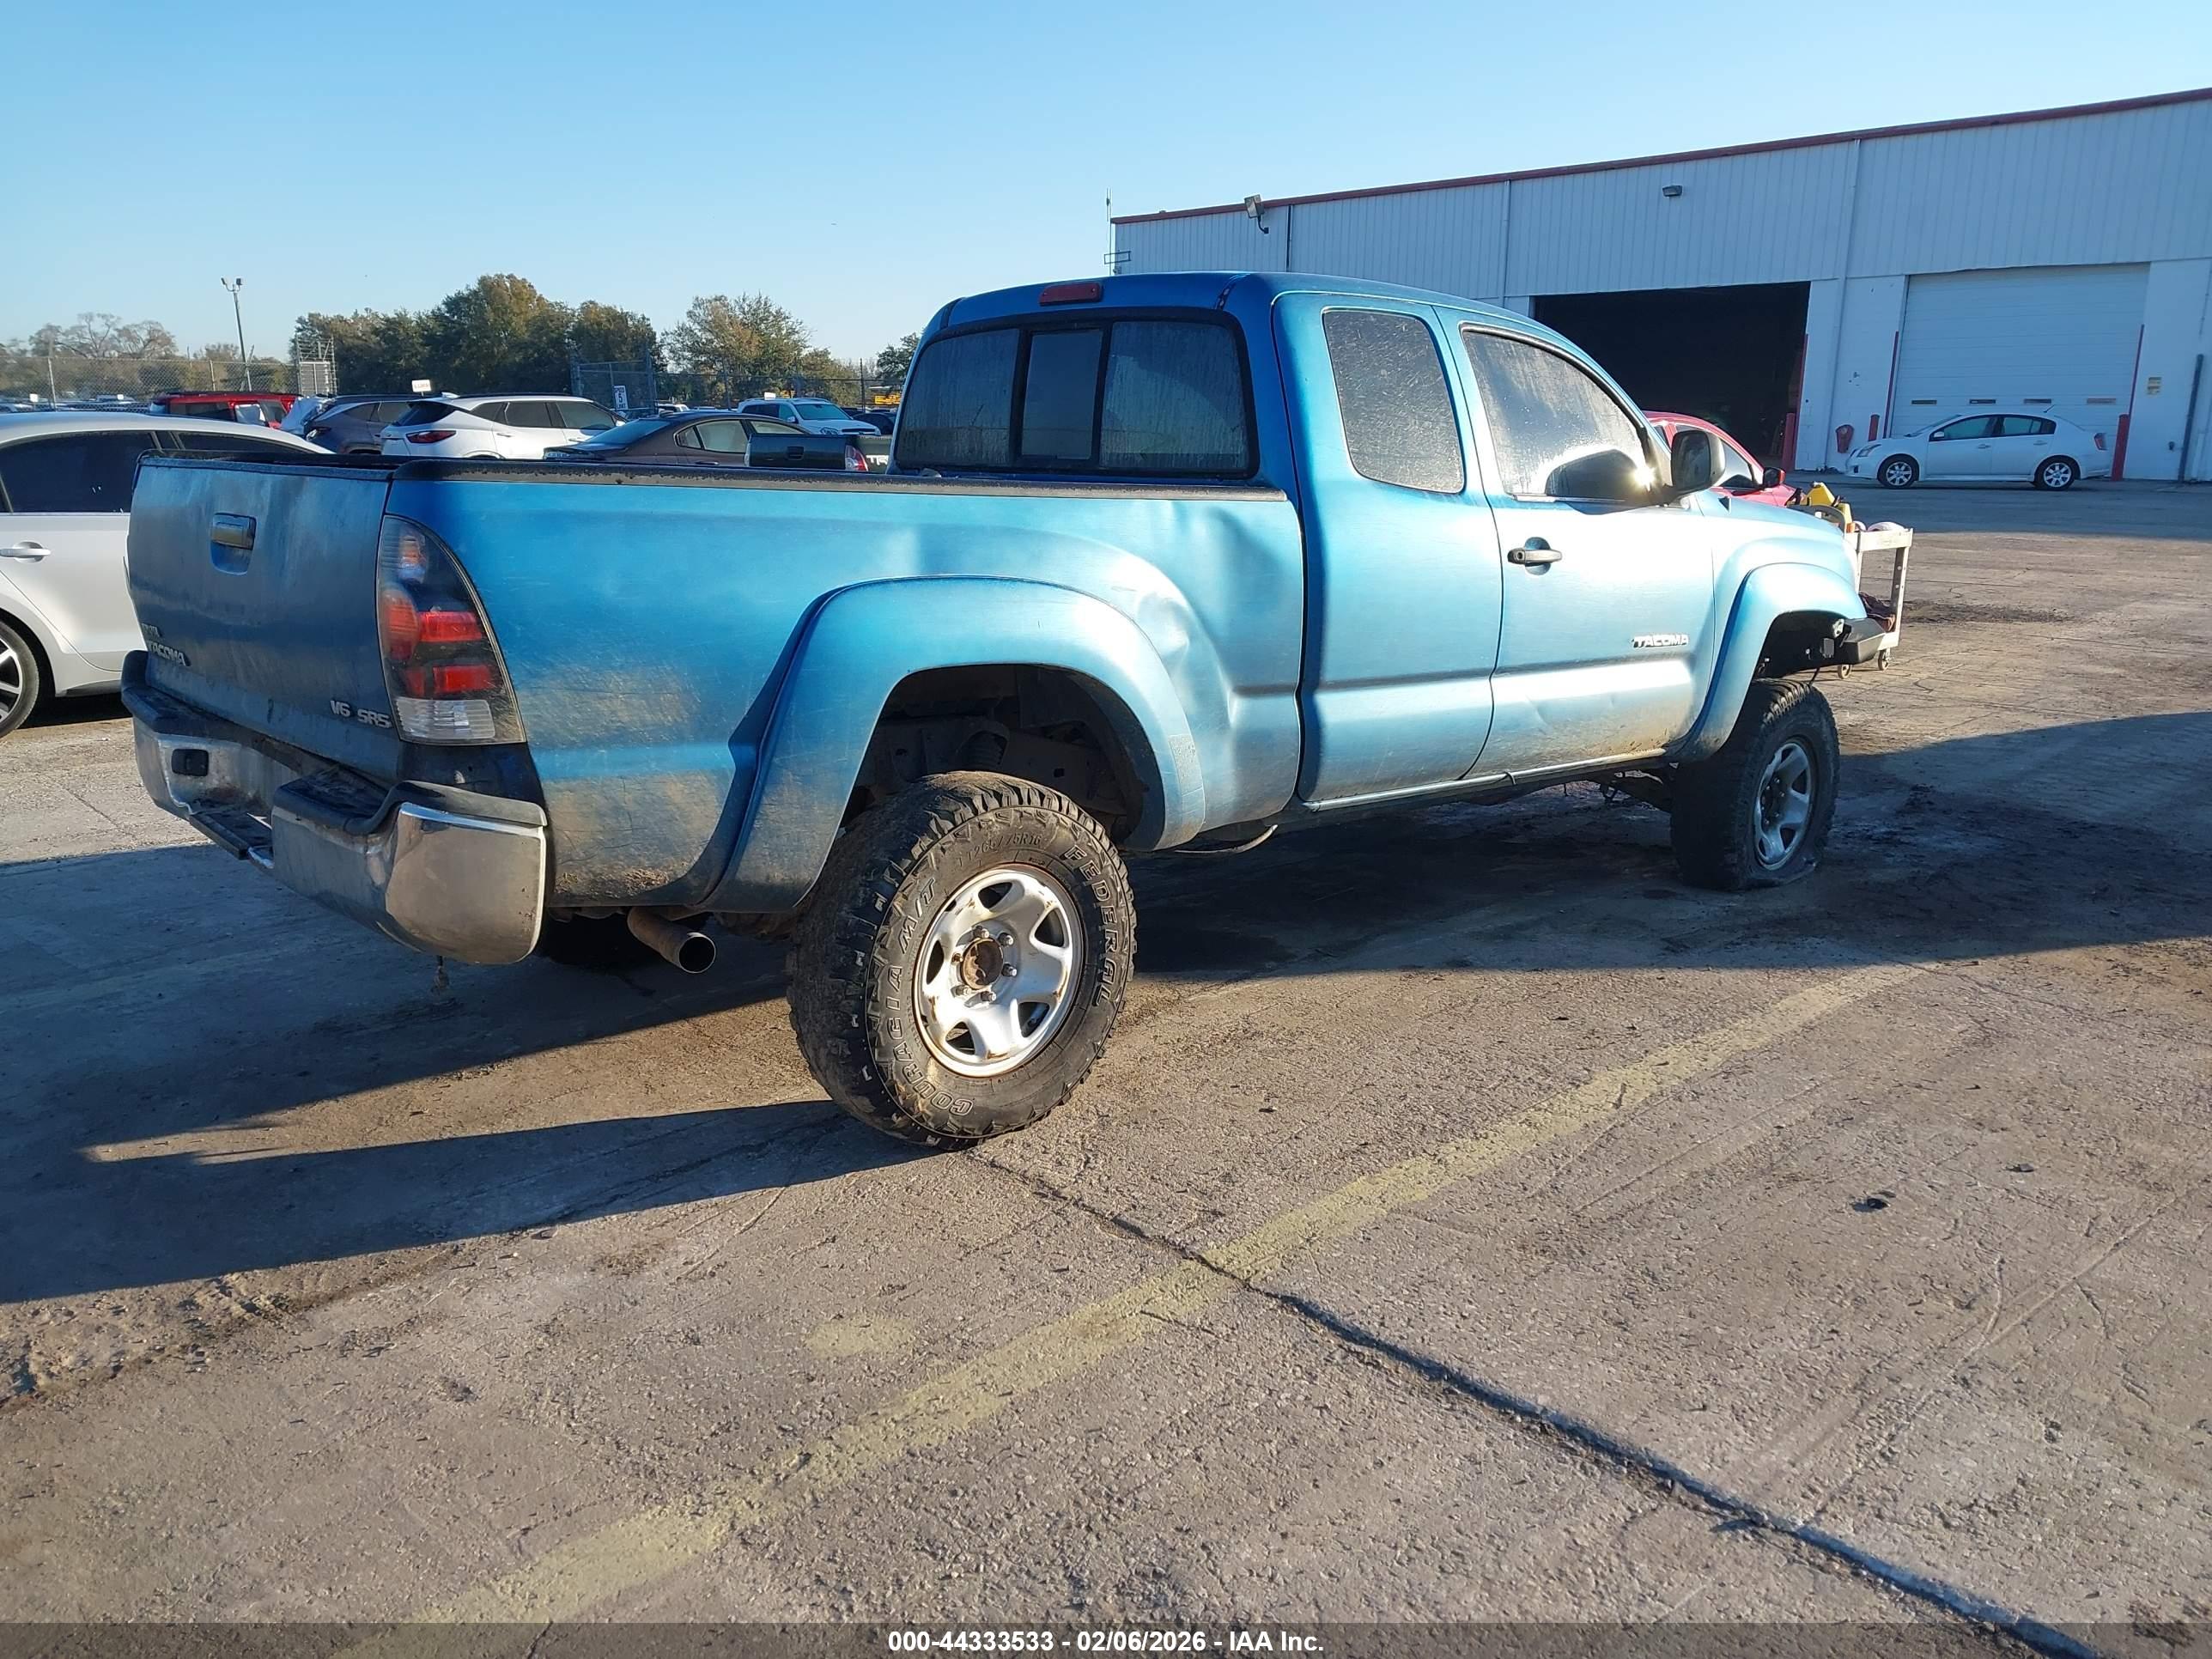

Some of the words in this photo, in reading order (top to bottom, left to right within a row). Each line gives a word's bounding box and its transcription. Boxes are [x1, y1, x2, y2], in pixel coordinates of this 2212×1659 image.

[146, 639, 187, 667] TACOMA
[1633, 634, 1689, 648] TACOMA
[330, 700, 351, 718] V6
[356, 708, 392, 729] SR5
[897, 877, 936, 954] M/T
[1063, 844, 1119, 1006] FEDERAL
[886, 965, 974, 1116] COURAGIA
